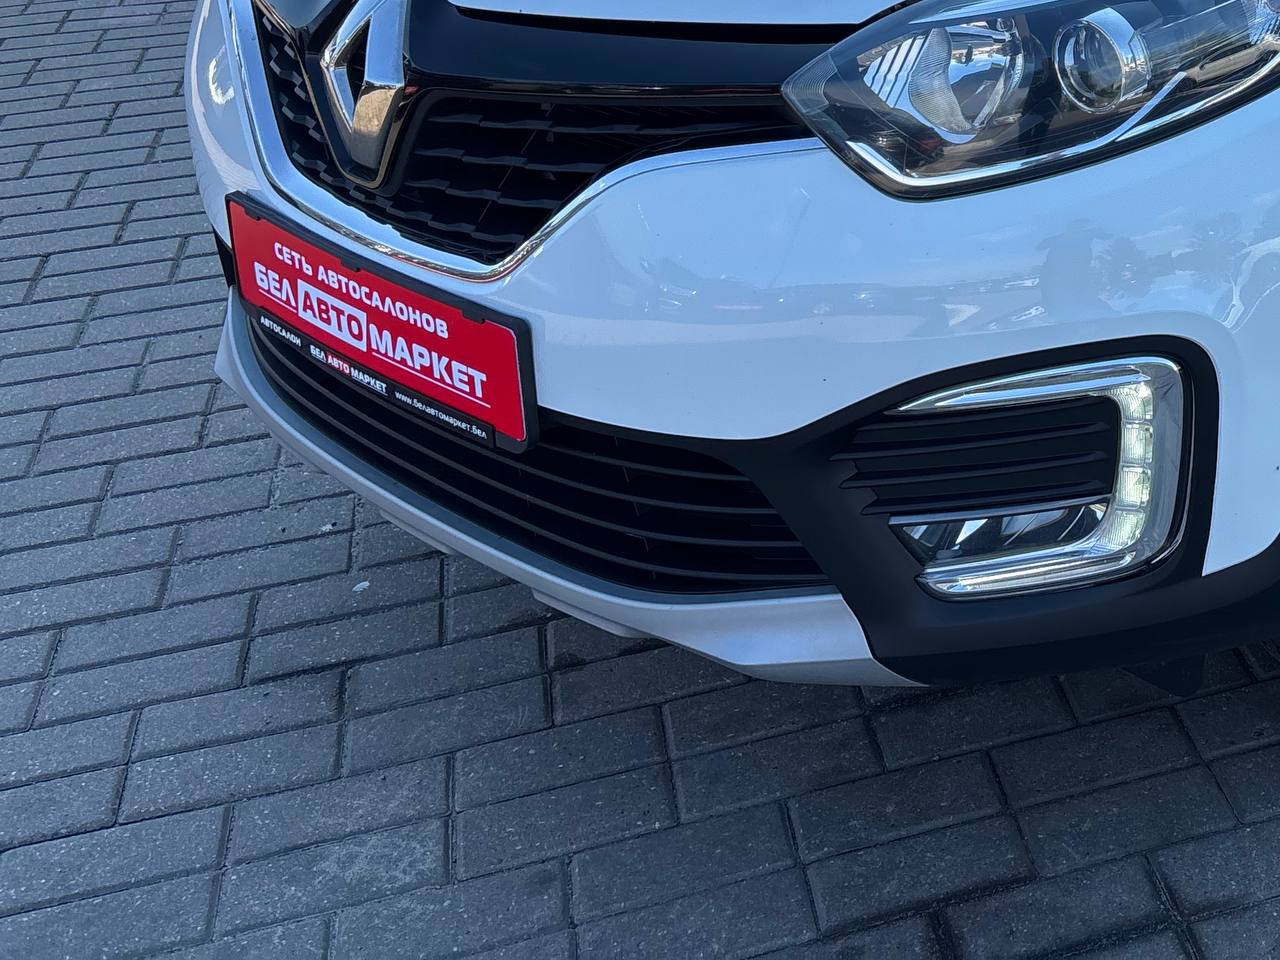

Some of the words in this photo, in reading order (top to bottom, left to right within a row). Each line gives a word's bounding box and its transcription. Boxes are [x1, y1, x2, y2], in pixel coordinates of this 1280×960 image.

[273, 241, 313, 276] СЕТЬ
[317, 265, 449, 339] АВТОСАЛОНОВ
[253, 261, 297, 307] БЕЛ
[301, 287, 365, 344] АВТО
[368, 323, 487, 398] МАРКЕТ
[260, 315, 302, 347] АВТОСАЛОН
[310, 344, 327, 362] БЕЛ
[327, 354, 350, 374] АВТО
[350, 366, 387, 393] МАРКЕТ
